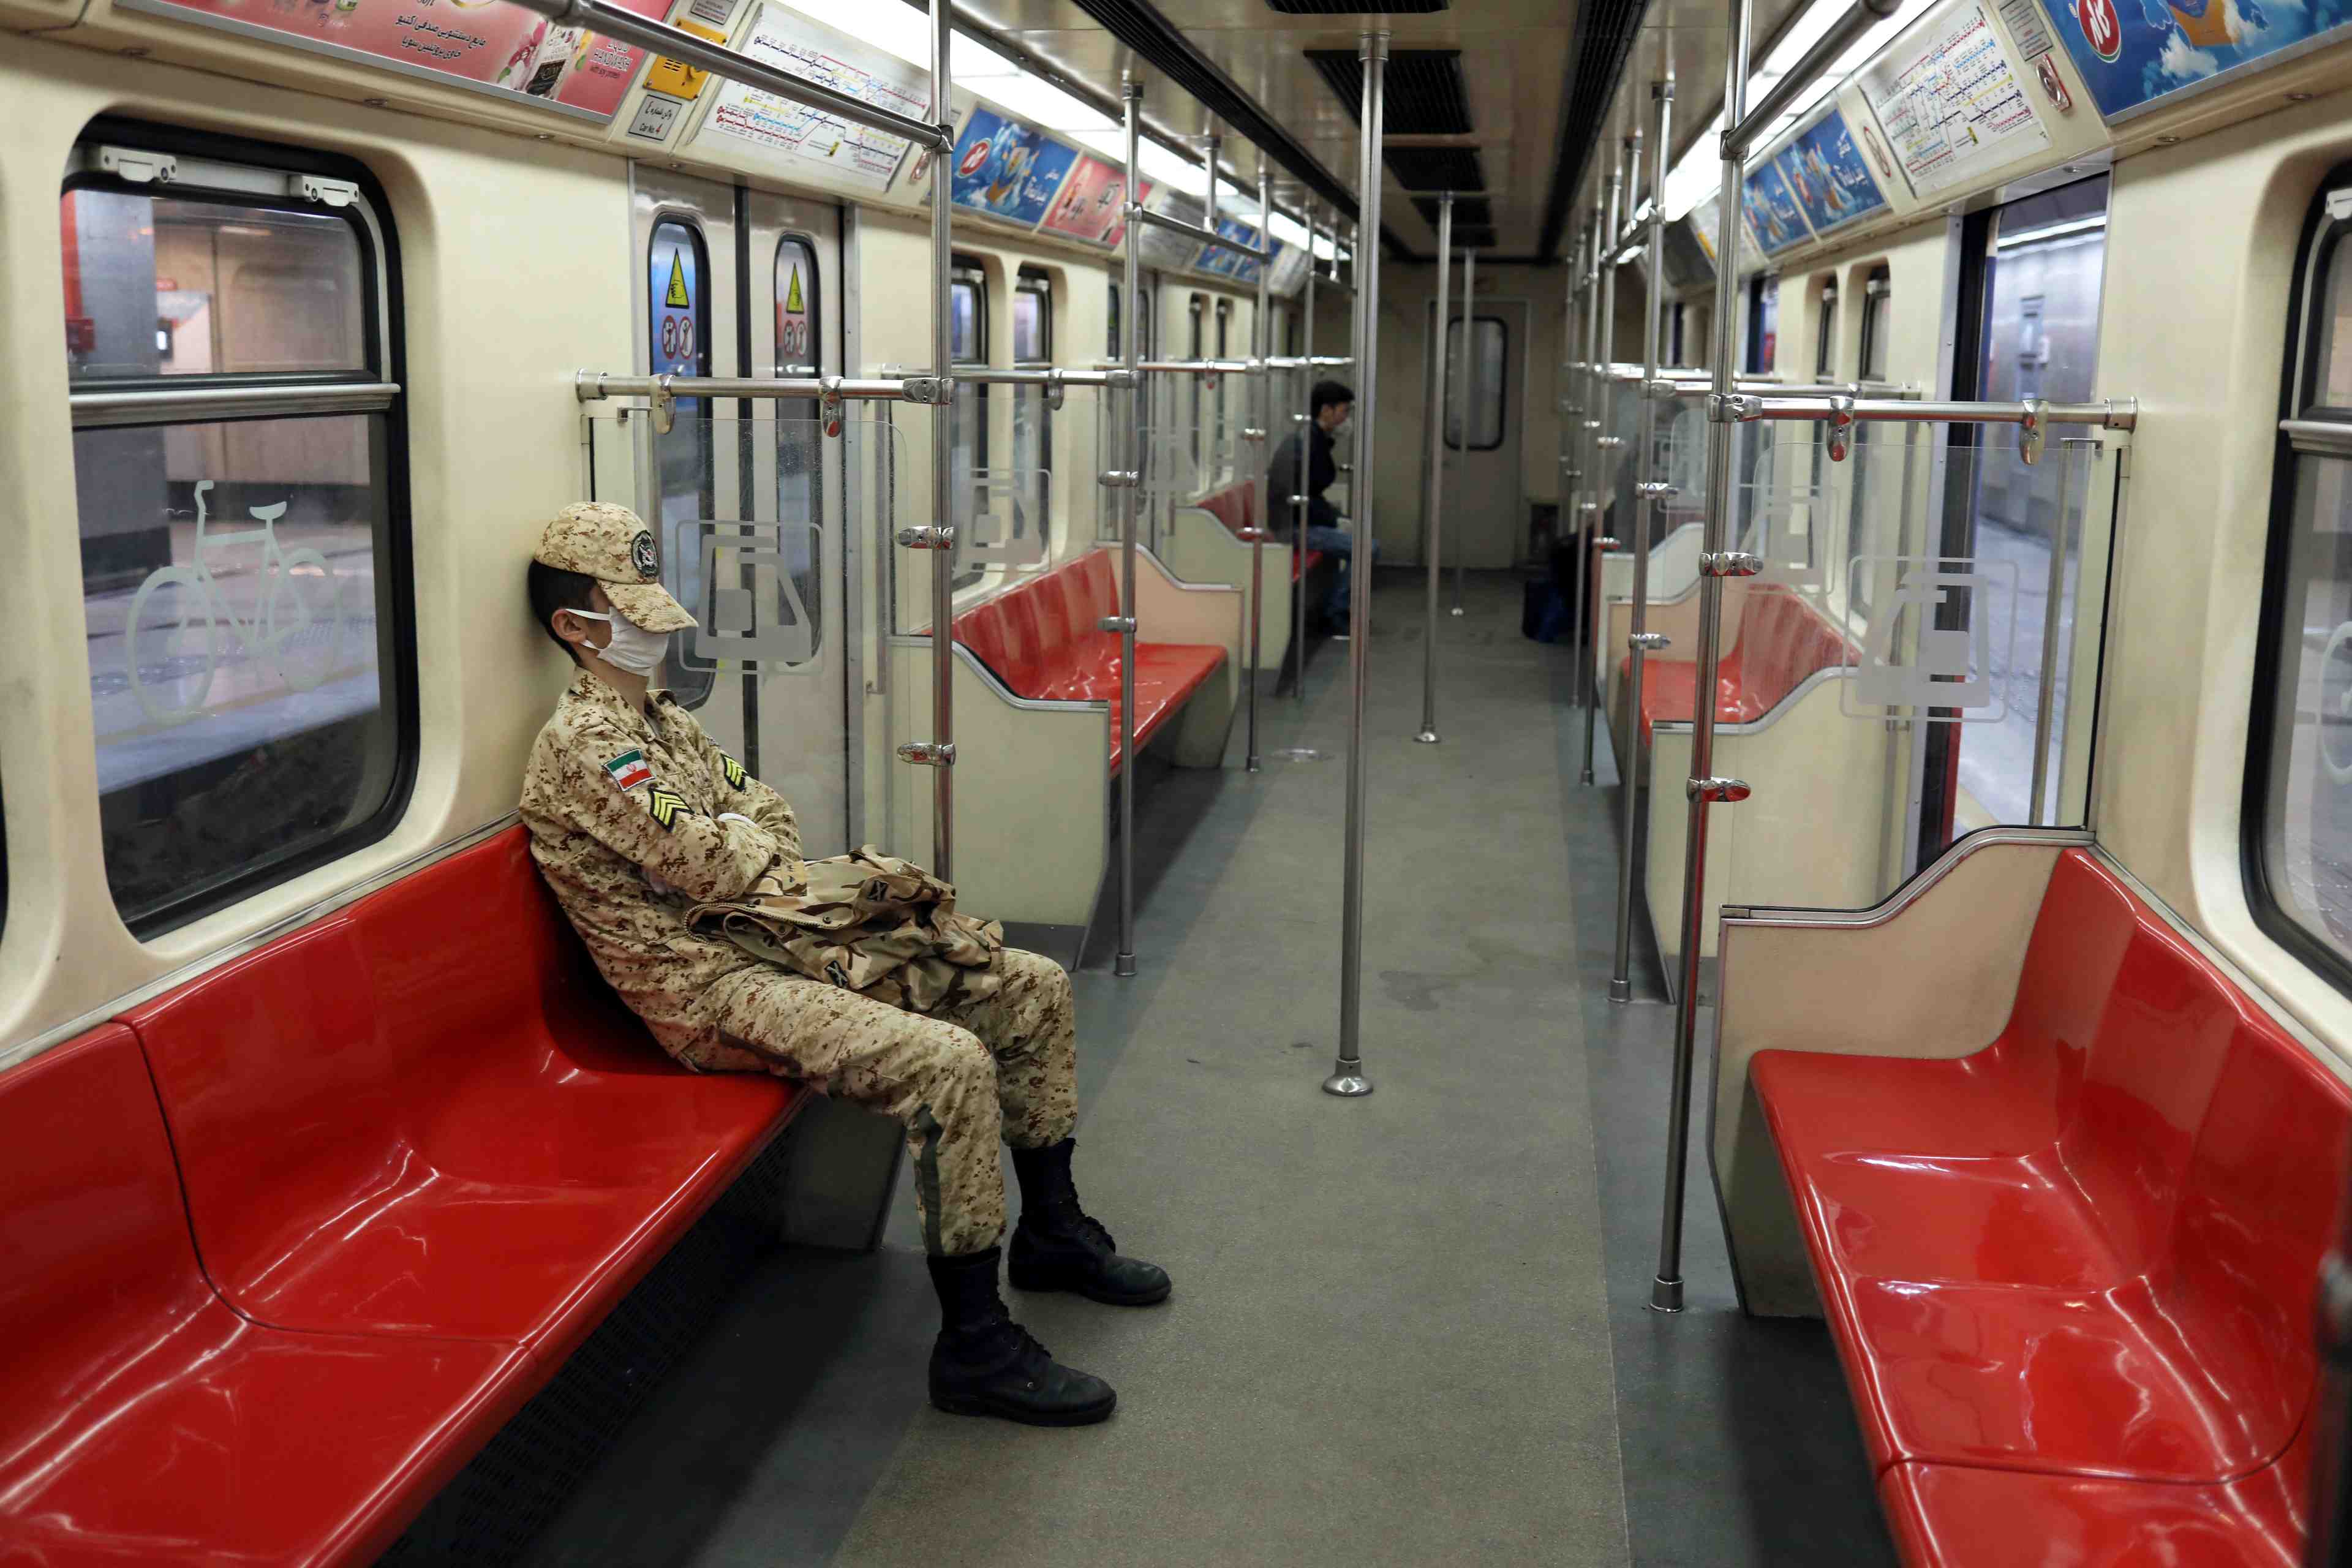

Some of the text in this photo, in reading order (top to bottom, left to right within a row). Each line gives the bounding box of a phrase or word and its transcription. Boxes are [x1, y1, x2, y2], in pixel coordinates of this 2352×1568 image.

[395, 14, 417, 26] اکتیو
[589, 48, 633, 72] HANDWASH
[639, 123, 649, 132] Car
